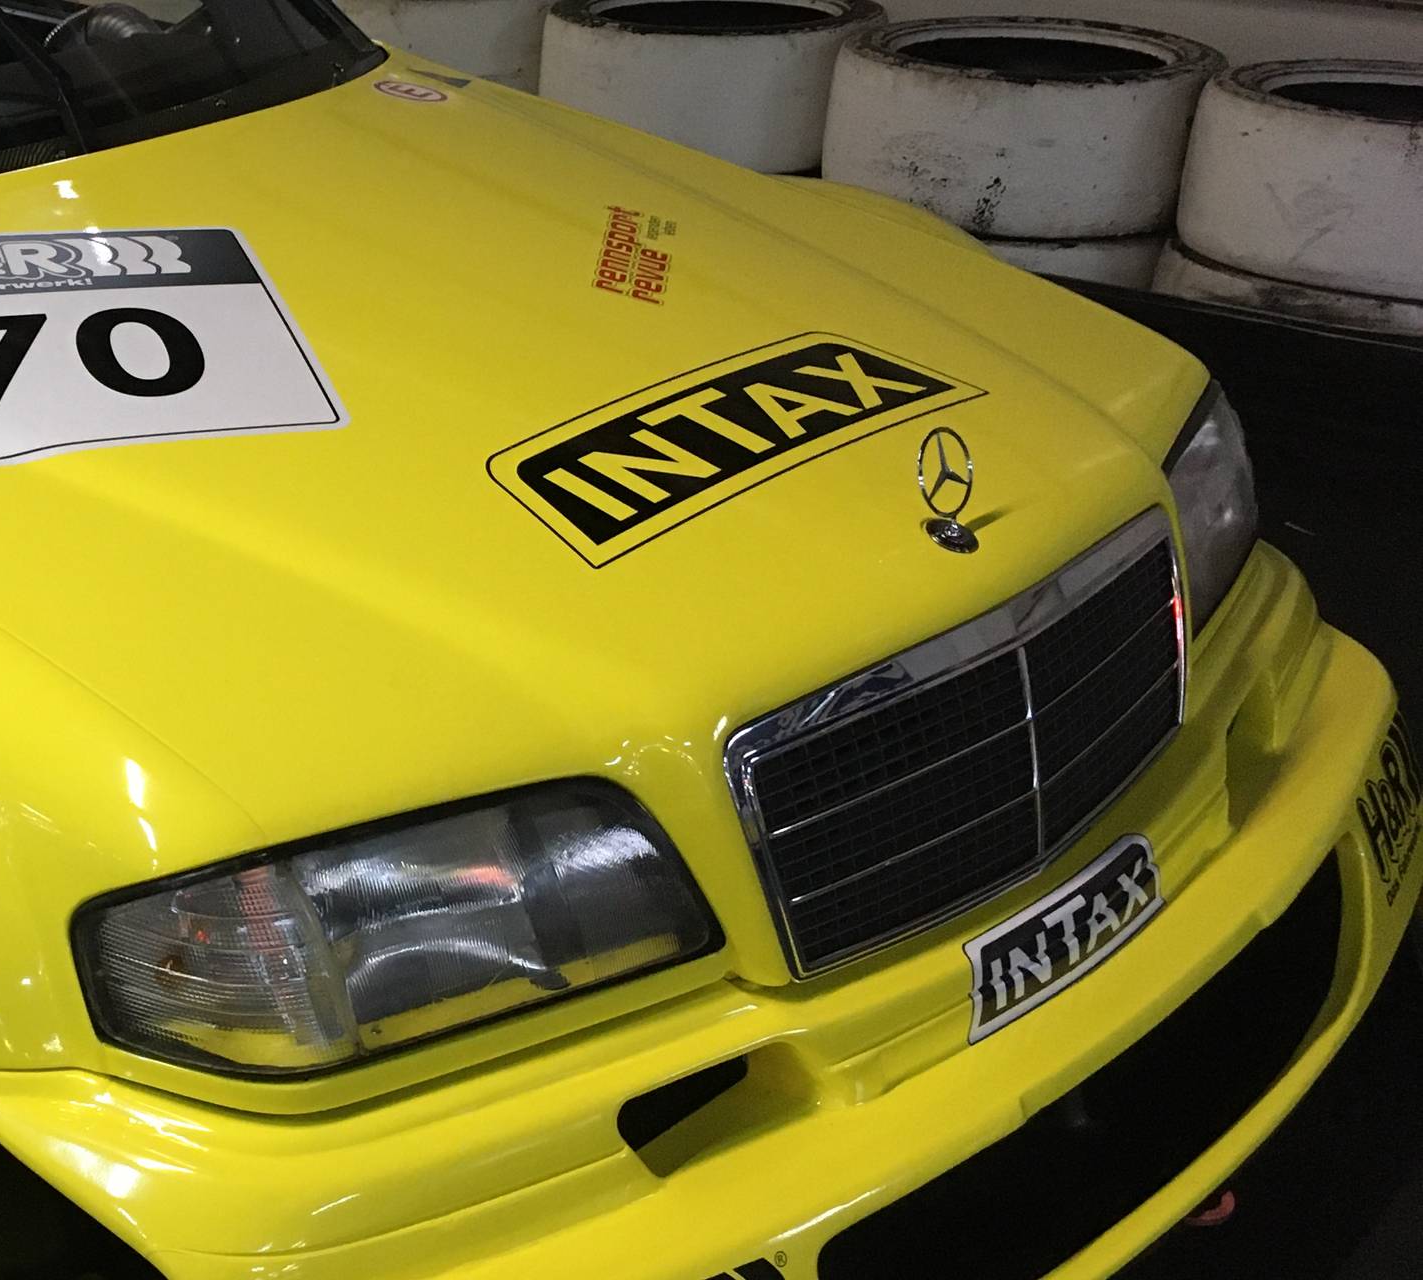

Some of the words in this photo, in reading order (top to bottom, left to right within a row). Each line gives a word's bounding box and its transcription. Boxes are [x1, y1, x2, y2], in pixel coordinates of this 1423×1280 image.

[595, 205, 643, 294] rennsport
[631, 248, 669, 305] revue
[543, 352, 928, 521] INTAX
[1356, 739, 1417, 882] H&R
[989, 856, 1149, 1011] INTAX
